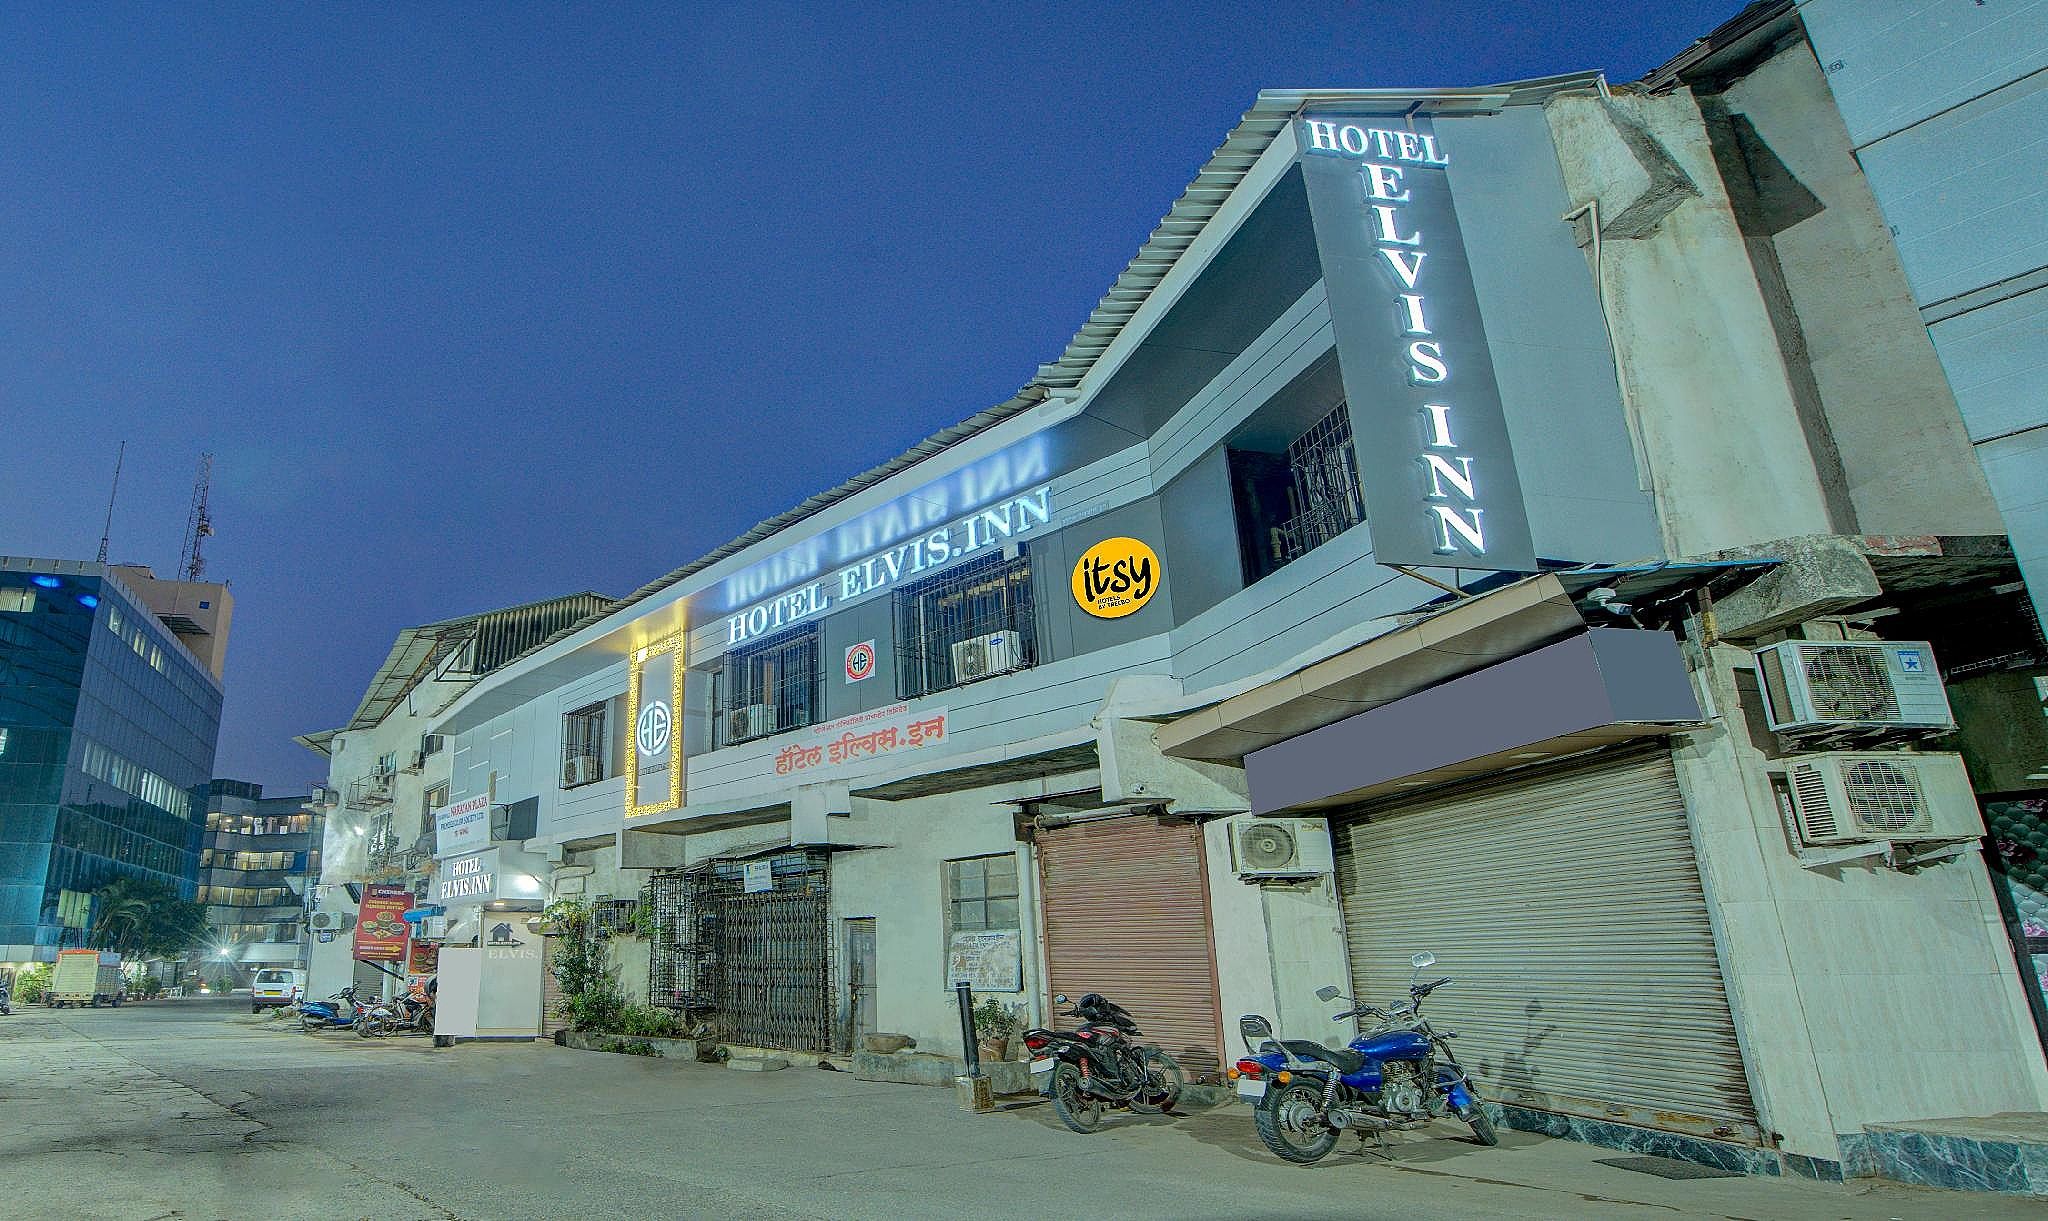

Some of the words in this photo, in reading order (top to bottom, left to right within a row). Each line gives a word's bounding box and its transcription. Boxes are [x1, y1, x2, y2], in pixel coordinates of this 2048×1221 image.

[1306, 119, 1449, 165] HOTEL
[1361, 162, 1450, 383] ELVIS
[1422, 404, 1486, 555] INN
[1083, 555, 1152, 602] itsy
[1097, 594, 1121, 605] HOTELS
[727, 584, 831, 646] HOTEL
[452, 857, 481, 877] HOTEL
